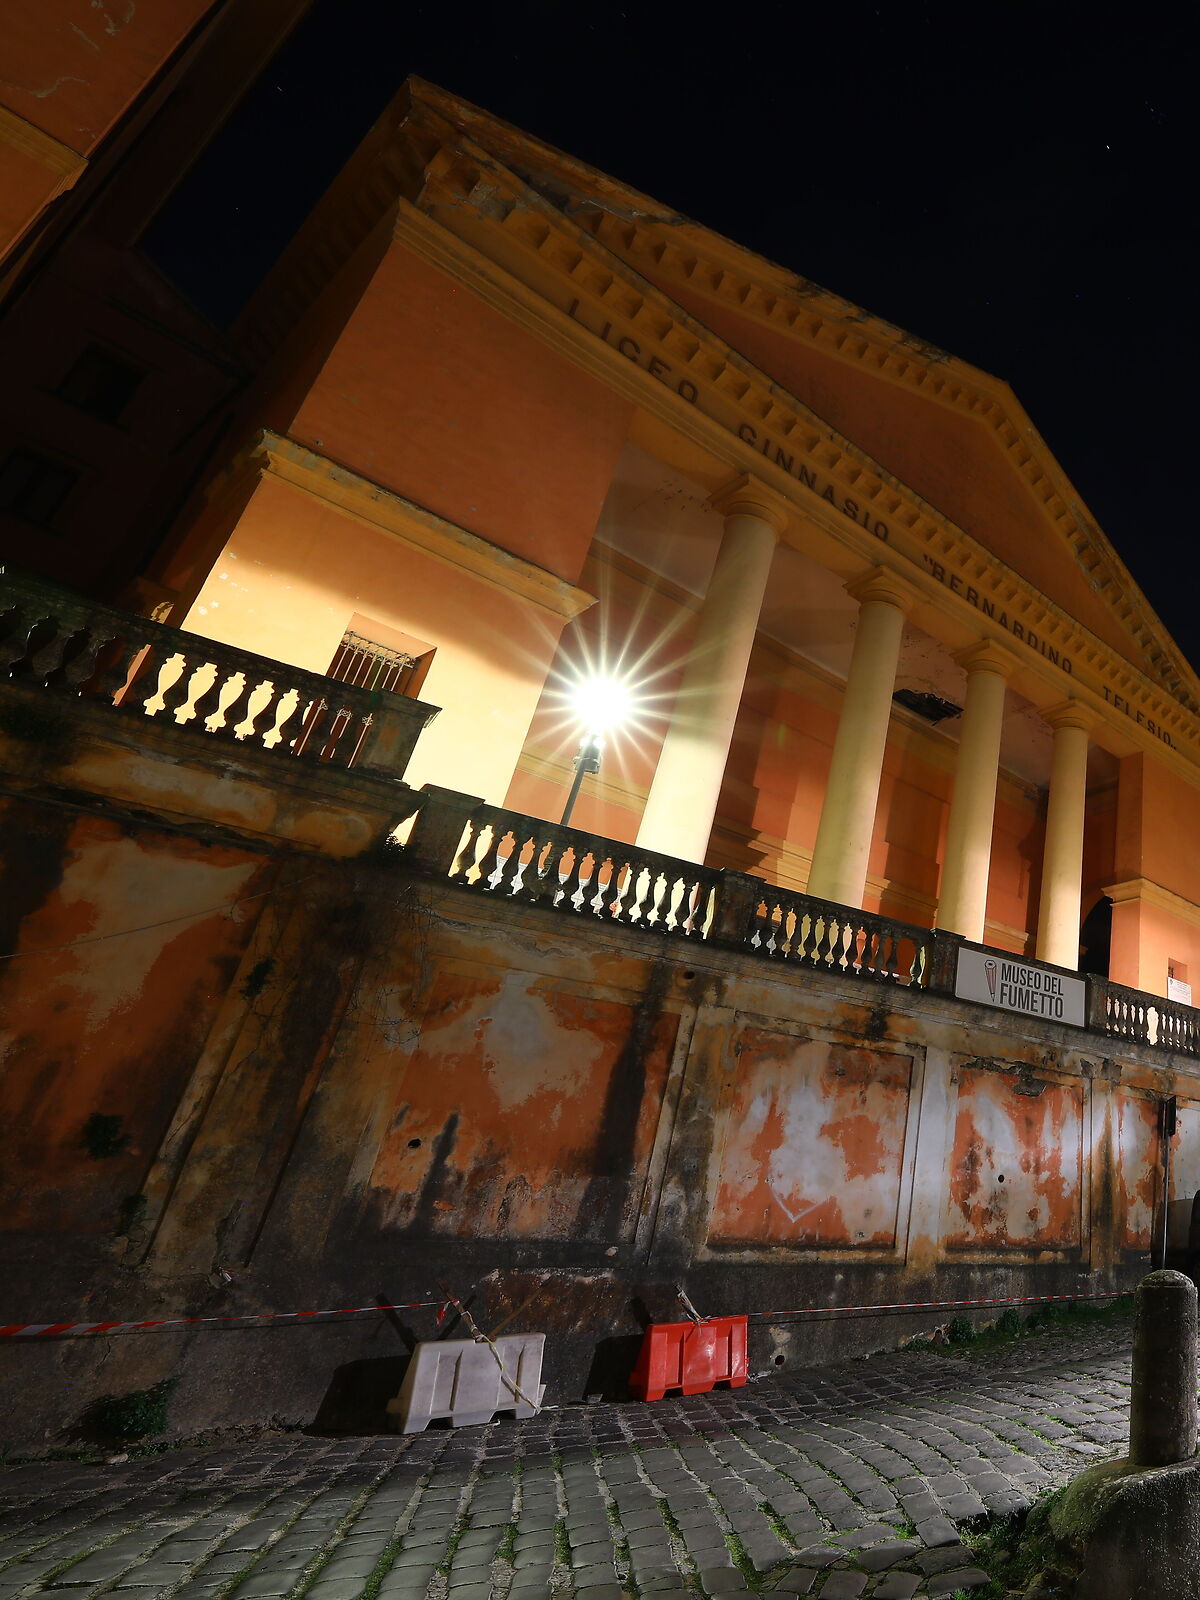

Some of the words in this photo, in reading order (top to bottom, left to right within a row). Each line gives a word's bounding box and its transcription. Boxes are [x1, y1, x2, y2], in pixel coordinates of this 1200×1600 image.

[567, 298, 699, 405] LICEO
[738, 422, 889, 542] GINNASIO
[1001, 963, 1041, 990] MUSEO
[1043, 975, 1064, 997] DEL
[1000, 983, 1064, 1019] FUMETTO
